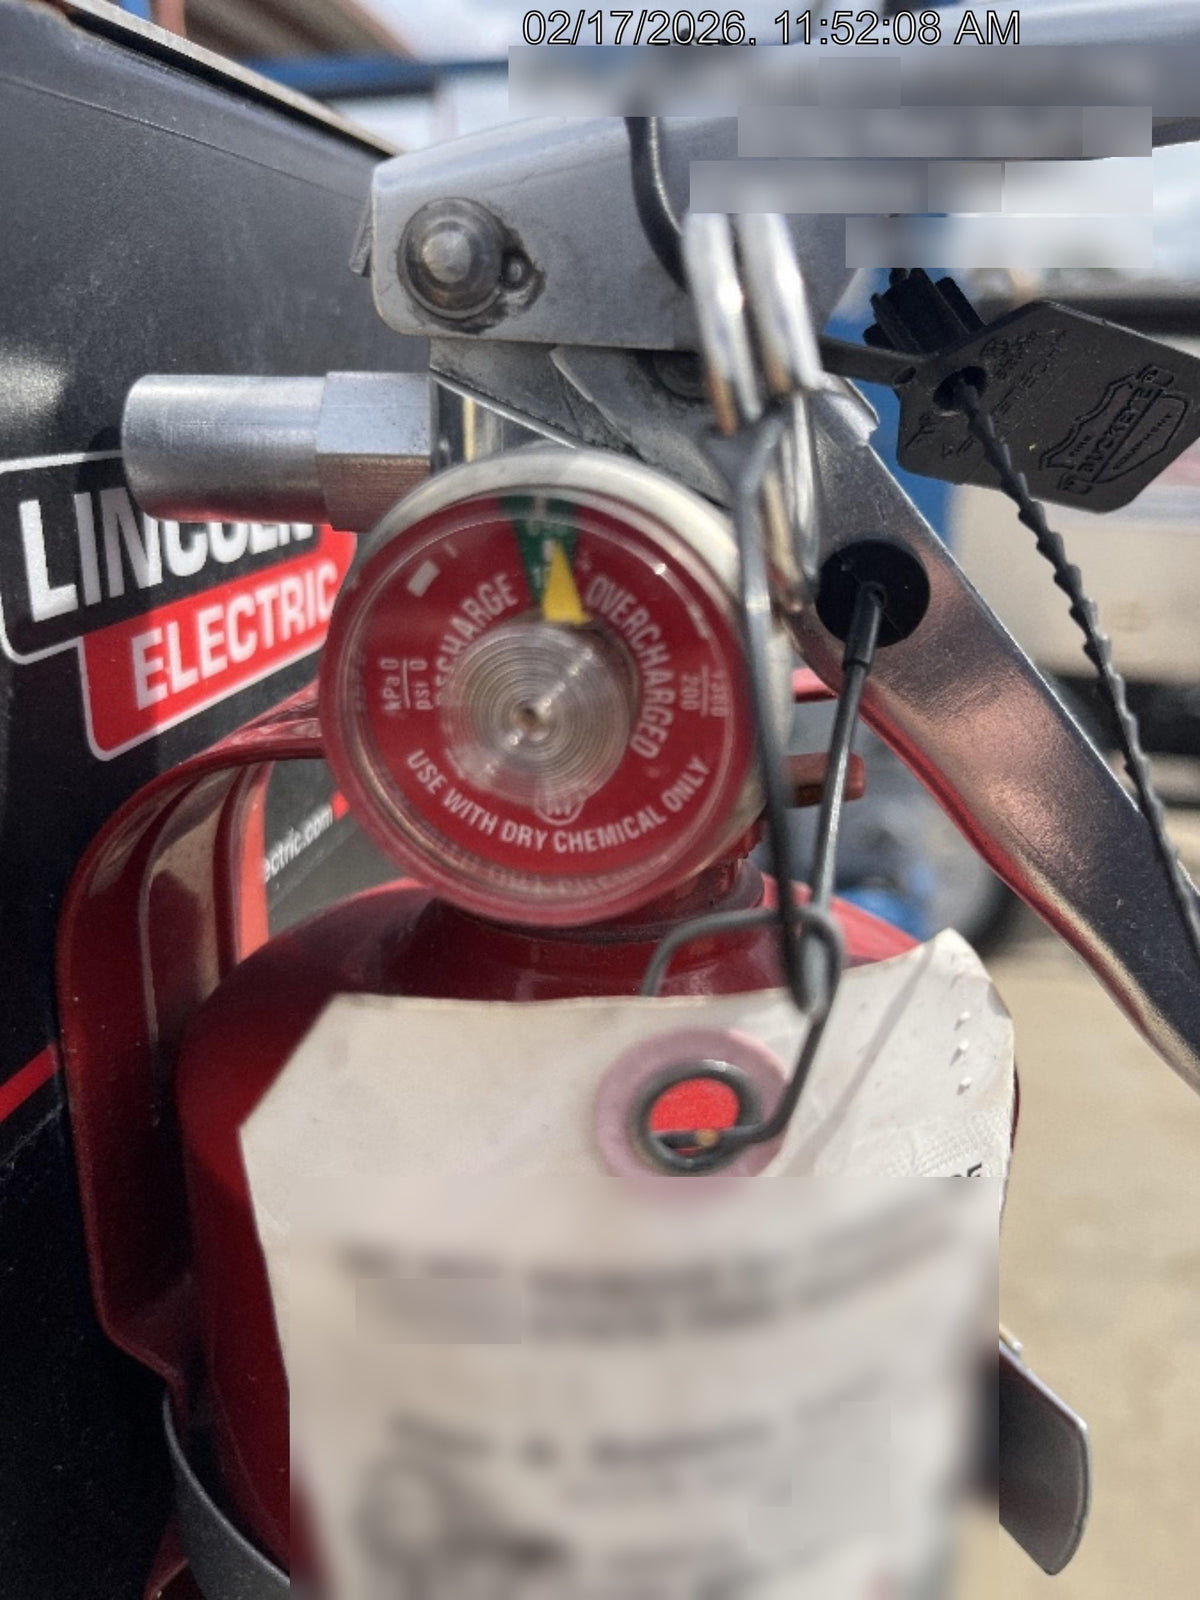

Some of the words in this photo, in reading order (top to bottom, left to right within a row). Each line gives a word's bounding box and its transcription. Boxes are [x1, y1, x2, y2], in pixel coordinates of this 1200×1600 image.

[19, 487, 314, 622] LINC
[131, 560, 339, 711] ELECTRIC
[409, 659, 428, 671] 0
[584, 574, 673, 759] OVERCHARGED
[406, 749, 448, 795] USE
[441, 787, 498, 836] WITH
[501, 818, 547, 851] DRY
[553, 810, 667, 855] CHEMICAL
[661, 756, 711, 812] ONLY
